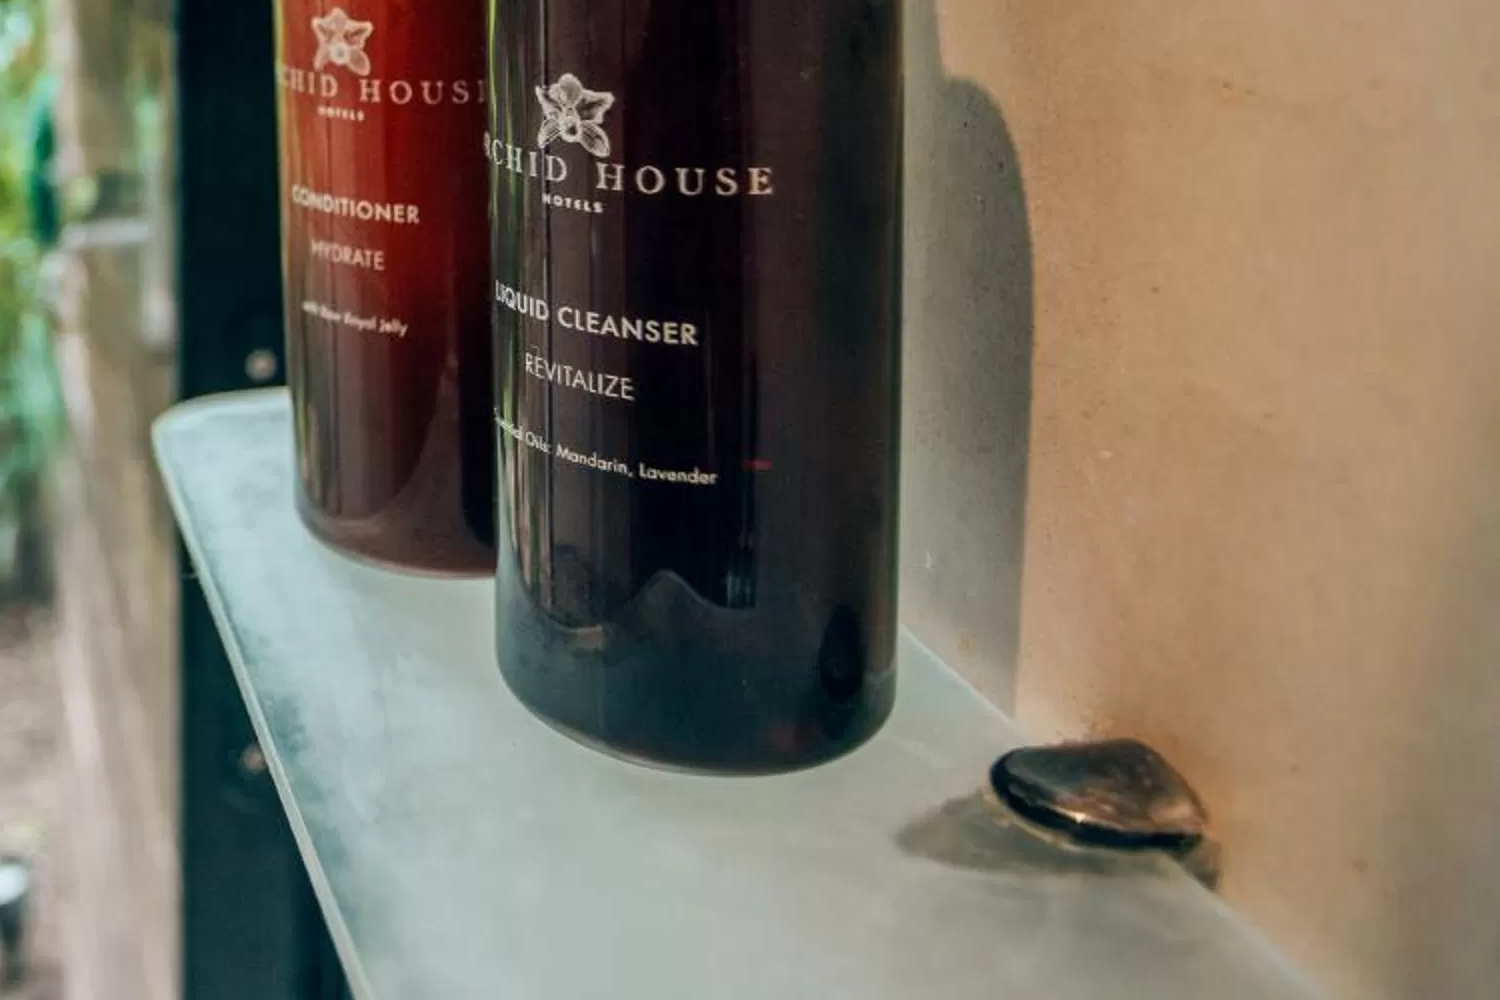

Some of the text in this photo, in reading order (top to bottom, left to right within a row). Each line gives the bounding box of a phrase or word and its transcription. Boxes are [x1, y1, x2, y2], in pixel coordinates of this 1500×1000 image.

[595, 161, 774, 197] HOUSE
[292, 183, 420, 224] CONDITIONER
[542, 193, 604, 213] HOTELS
[311, 239, 385, 271] HYDRATE
[380, 316, 409, 338] Jelly
[495, 279, 700, 348] LIQUID CLEANSER
[524, 352, 636, 401] REVITALIZE
[555, 443, 634, 477] Mandarin,
[639, 463, 719, 485] Lavender
